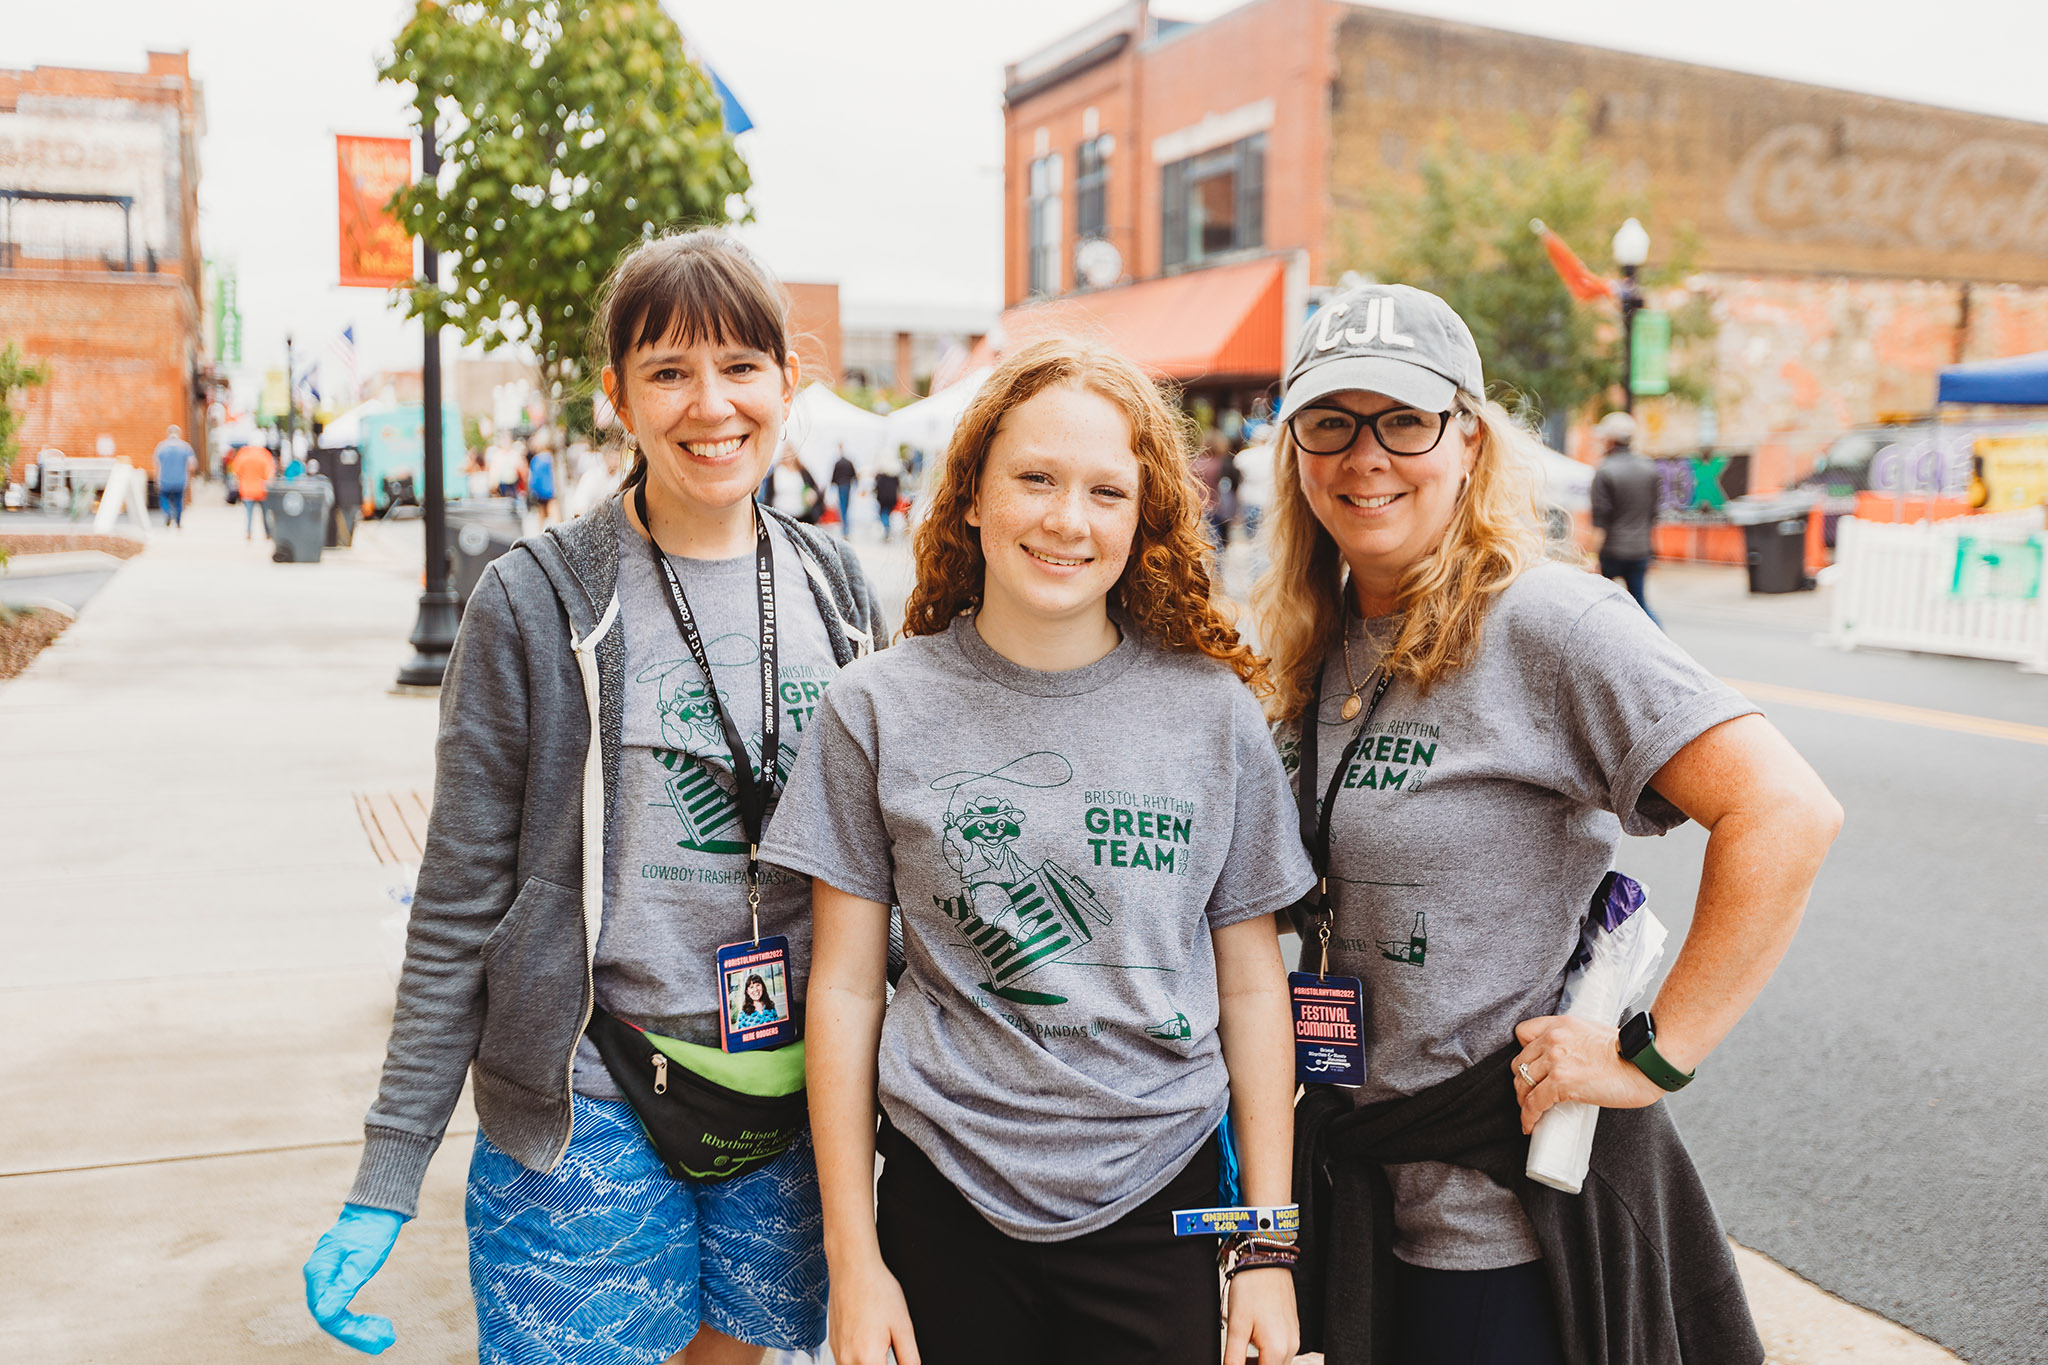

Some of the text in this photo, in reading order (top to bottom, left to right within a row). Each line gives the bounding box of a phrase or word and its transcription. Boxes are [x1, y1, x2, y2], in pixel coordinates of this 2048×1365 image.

[1315, 296, 1415, 352] CJL
[670, 582, 692, 622] COUNTRY
[758, 571, 775, 651] BIRTHPLACE
[763, 652, 773, 662] of
[763, 662, 774, 706] COUNTRY
[765, 705, 774, 734] MUSIC
[1387, 720, 1440, 740] RHYTHM
[1355, 735, 1438, 767] REEN
[1343, 764, 1409, 791] EAM
[1407, 780, 1423, 792] 22
[1084, 790, 1195, 816] BRISTOL RHYTHM
[1085, 807, 1192, 845] GREEN
[1087, 838, 1175, 874] TEAM
[642, 864, 695, 882] COWBOY
[698, 868, 731, 884] TRASH
[1294, 987, 1355, 998] #BRISTOLRHYTHM2022
[1301, 1005, 1350, 1023] FESTIVAL
[1035, 1023, 1088, 1038] PANDAS
[1296, 1021, 1357, 1039] COMMITTEE
[701, 1132, 754, 1149] Rhythm
[740, 1128, 779, 1140] Bristol
[1201, 1211, 1250, 1223] WEEKEND
[1214, 1221, 1239, 1231] 2022
